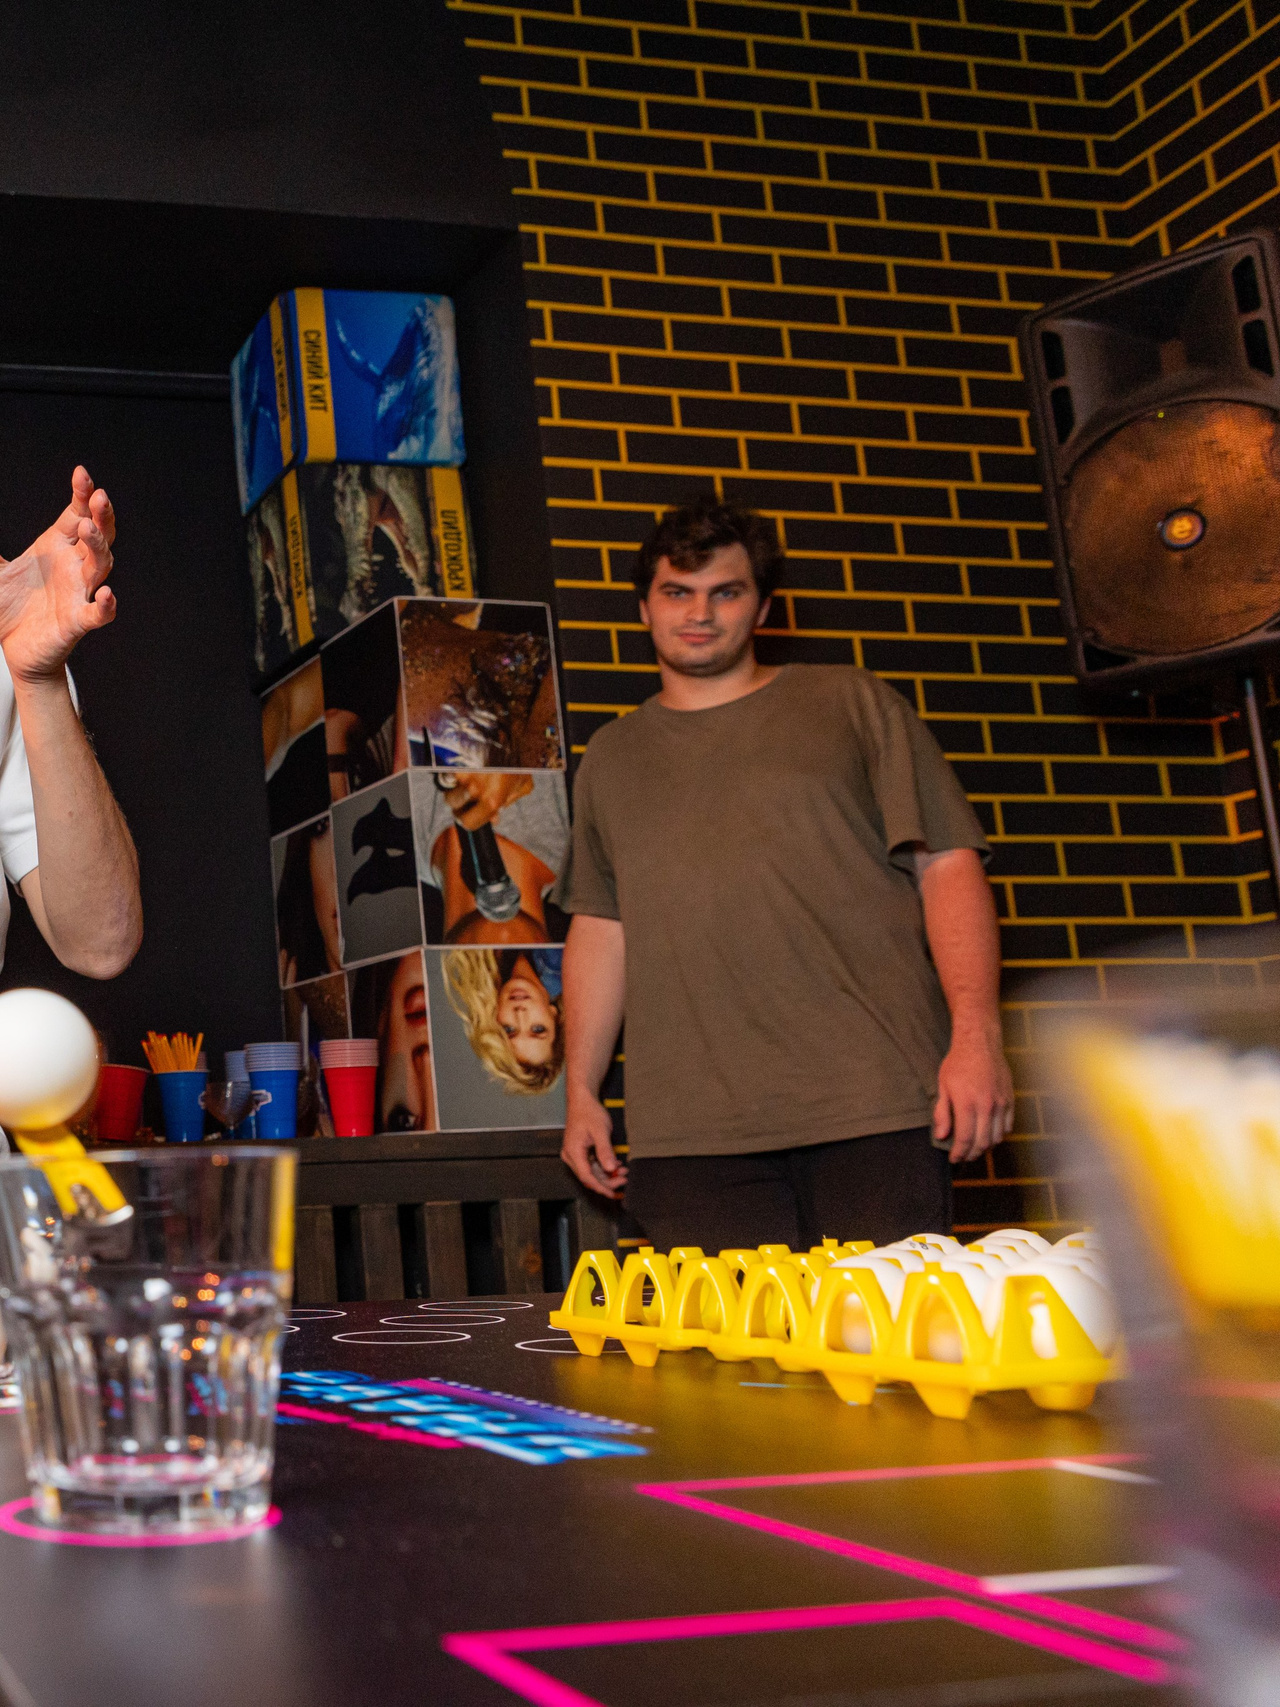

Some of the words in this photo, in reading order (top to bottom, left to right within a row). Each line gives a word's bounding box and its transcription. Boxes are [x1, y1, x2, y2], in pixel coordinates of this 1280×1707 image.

[304, 330, 328, 380] СИНИЙ
[308, 384, 328, 412] КИТ
[441, 509, 466, 591] КРОКОДИЛ
